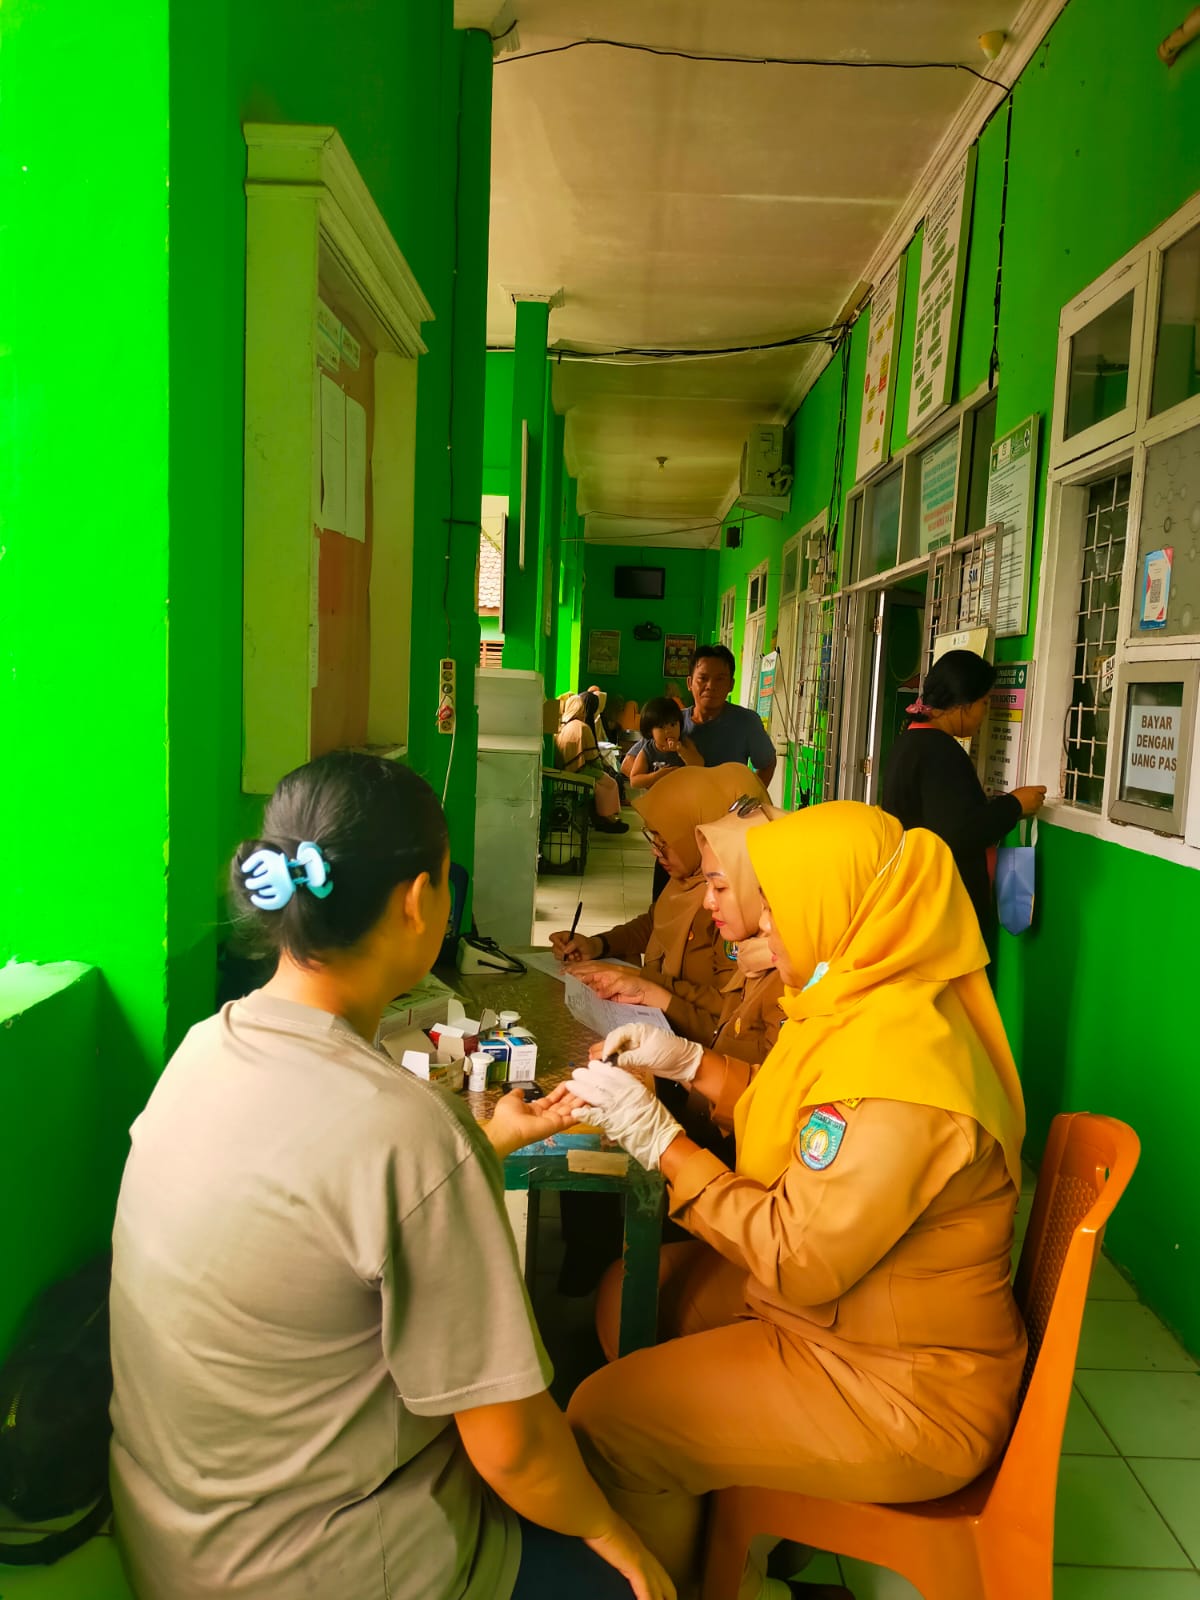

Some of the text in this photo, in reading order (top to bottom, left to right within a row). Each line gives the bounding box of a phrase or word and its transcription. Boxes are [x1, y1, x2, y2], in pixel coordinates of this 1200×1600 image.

[1106, 674, 1114, 687] OP
[1141, 715, 1173, 730] BAYAR
[1136, 734, 1175, 751] DENGAN
[1131, 752, 1177, 772] UANG PAS
